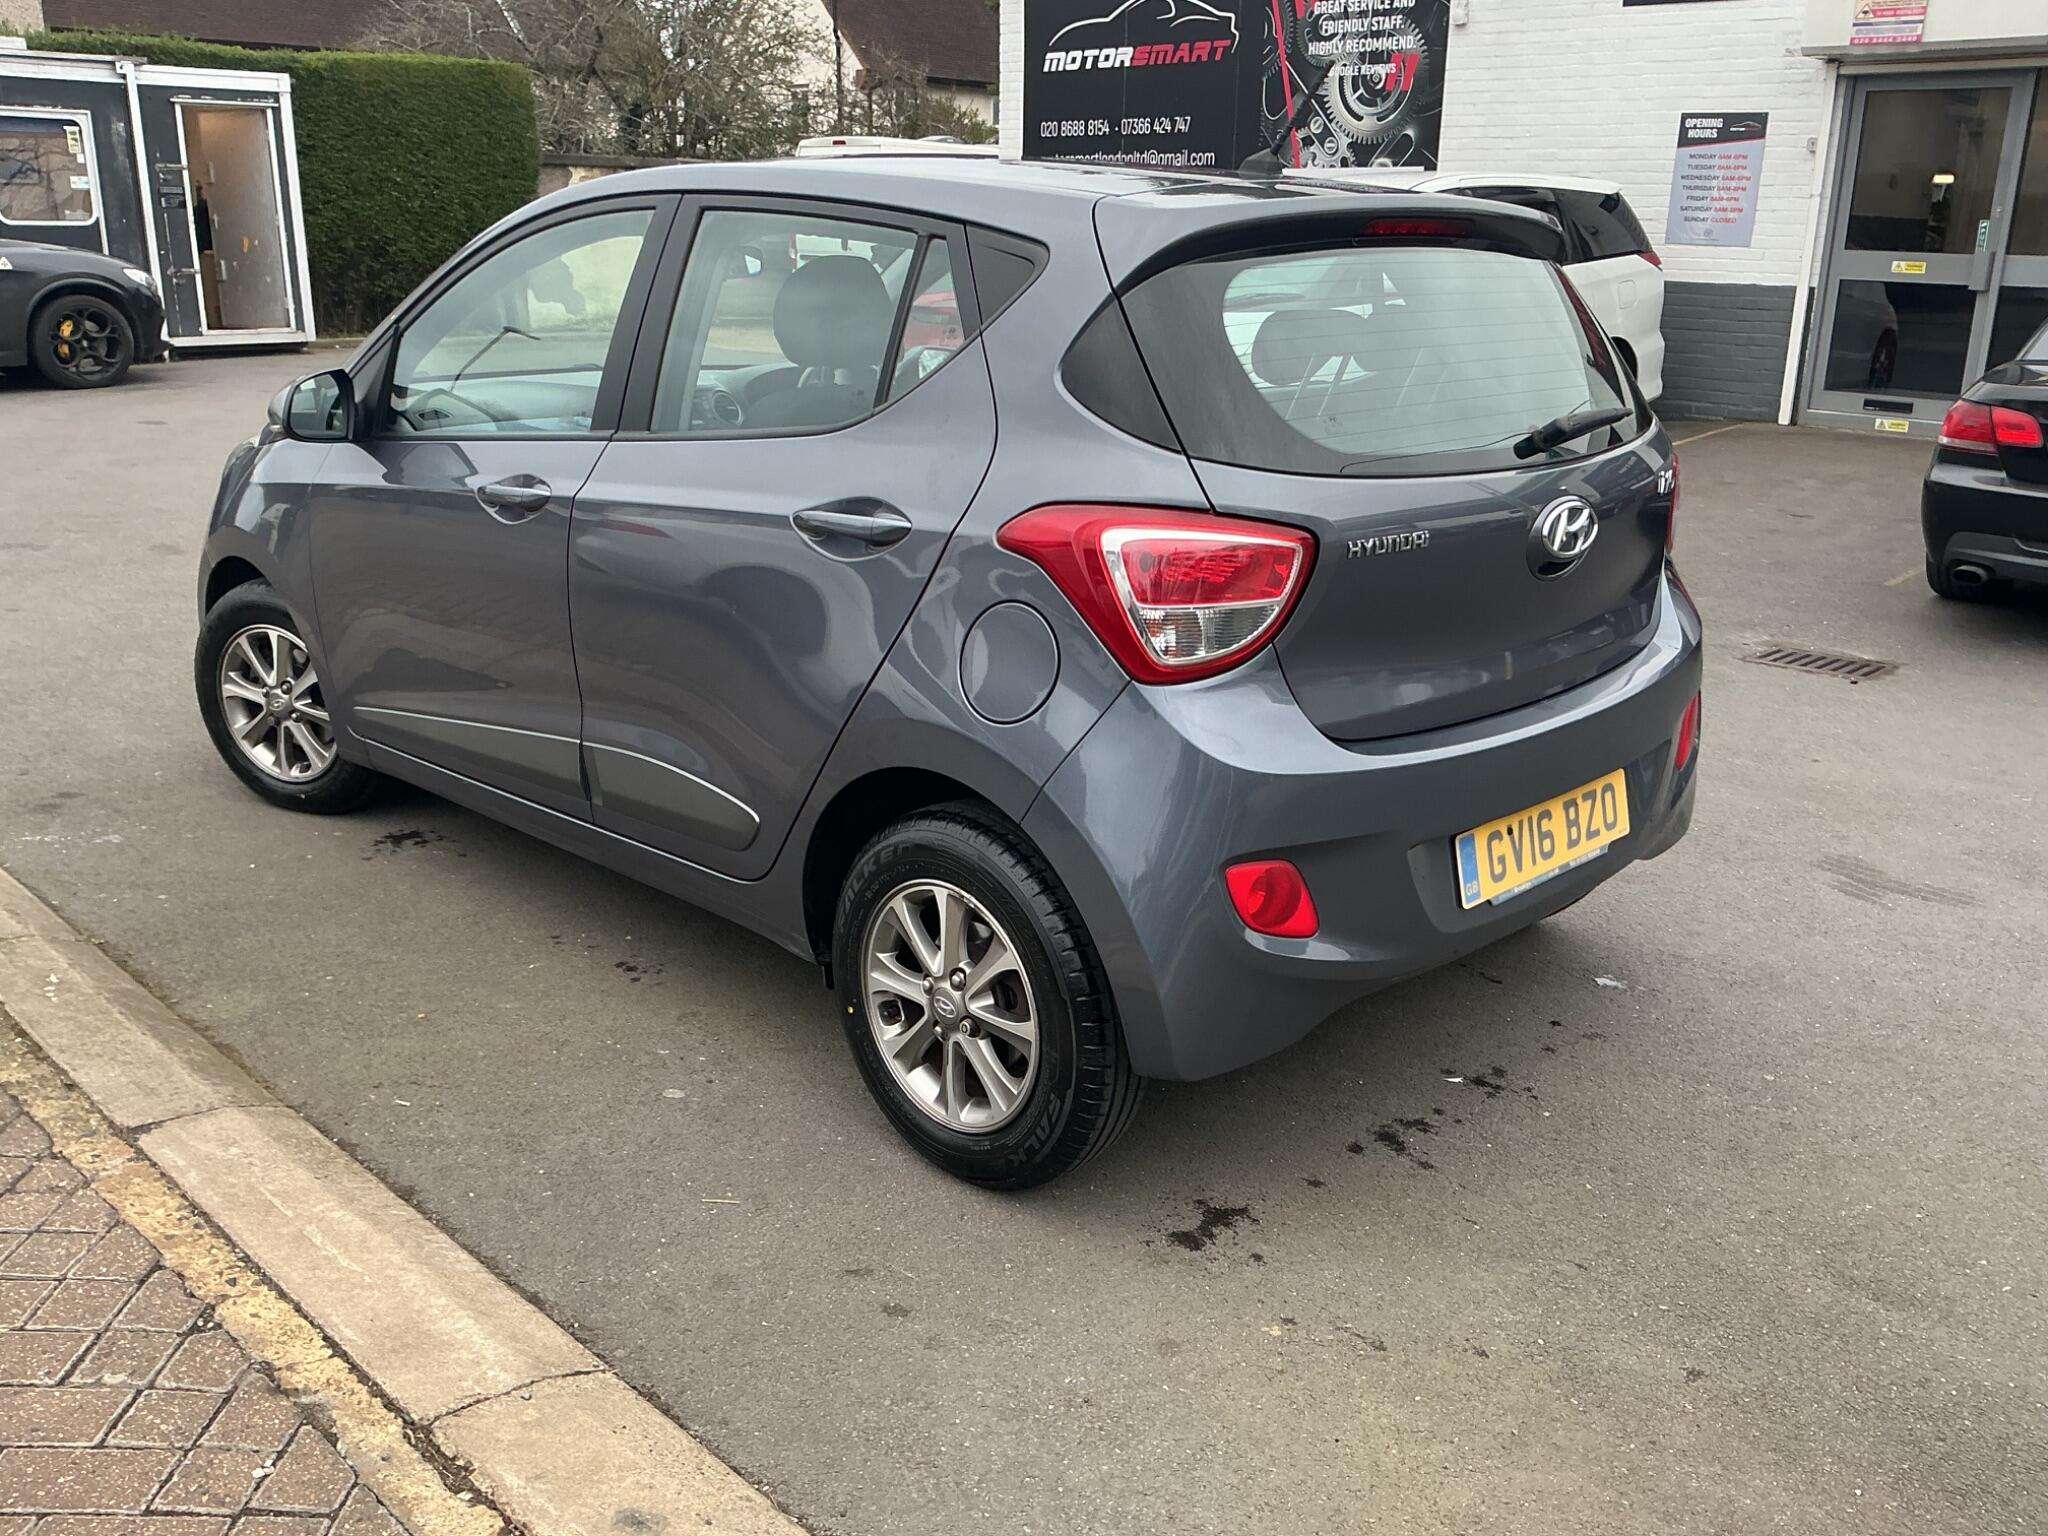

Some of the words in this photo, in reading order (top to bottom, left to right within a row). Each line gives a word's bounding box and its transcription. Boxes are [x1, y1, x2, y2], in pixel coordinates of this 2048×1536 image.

[1314, 0, 1346, 14] GREAT
[1348, 0, 1391, 12] SERVICE
[1393, 0, 1415, 8] AND
[1322, 17, 1370, 34] FRIENDLY
[1371, 15, 1405, 31] STAFF.
[1308, 40, 1344, 55] HIGHLY
[1345, 34, 1417, 52] RECOMMEND.
[1042, 39, 1232, 73] MOTORSMART
[1041, 121, 1058, 137] 020
[1061, 120, 1085, 137] 8688
[1088, 119, 1109, 136] 8154
[1121, 118, 1151, 135] 07366
[1153, 117, 1171, 133] 424
[1173, 116, 1191, 133] 747
[1685, 118, 1724, 128] OPENING
[1687, 128, 1718, 138] HOURS
[1347, 529, 1430, 559] HYUNDAI
[1485, 812, 1555, 886] GV16
[1465, 880, 1479, 897] GB
